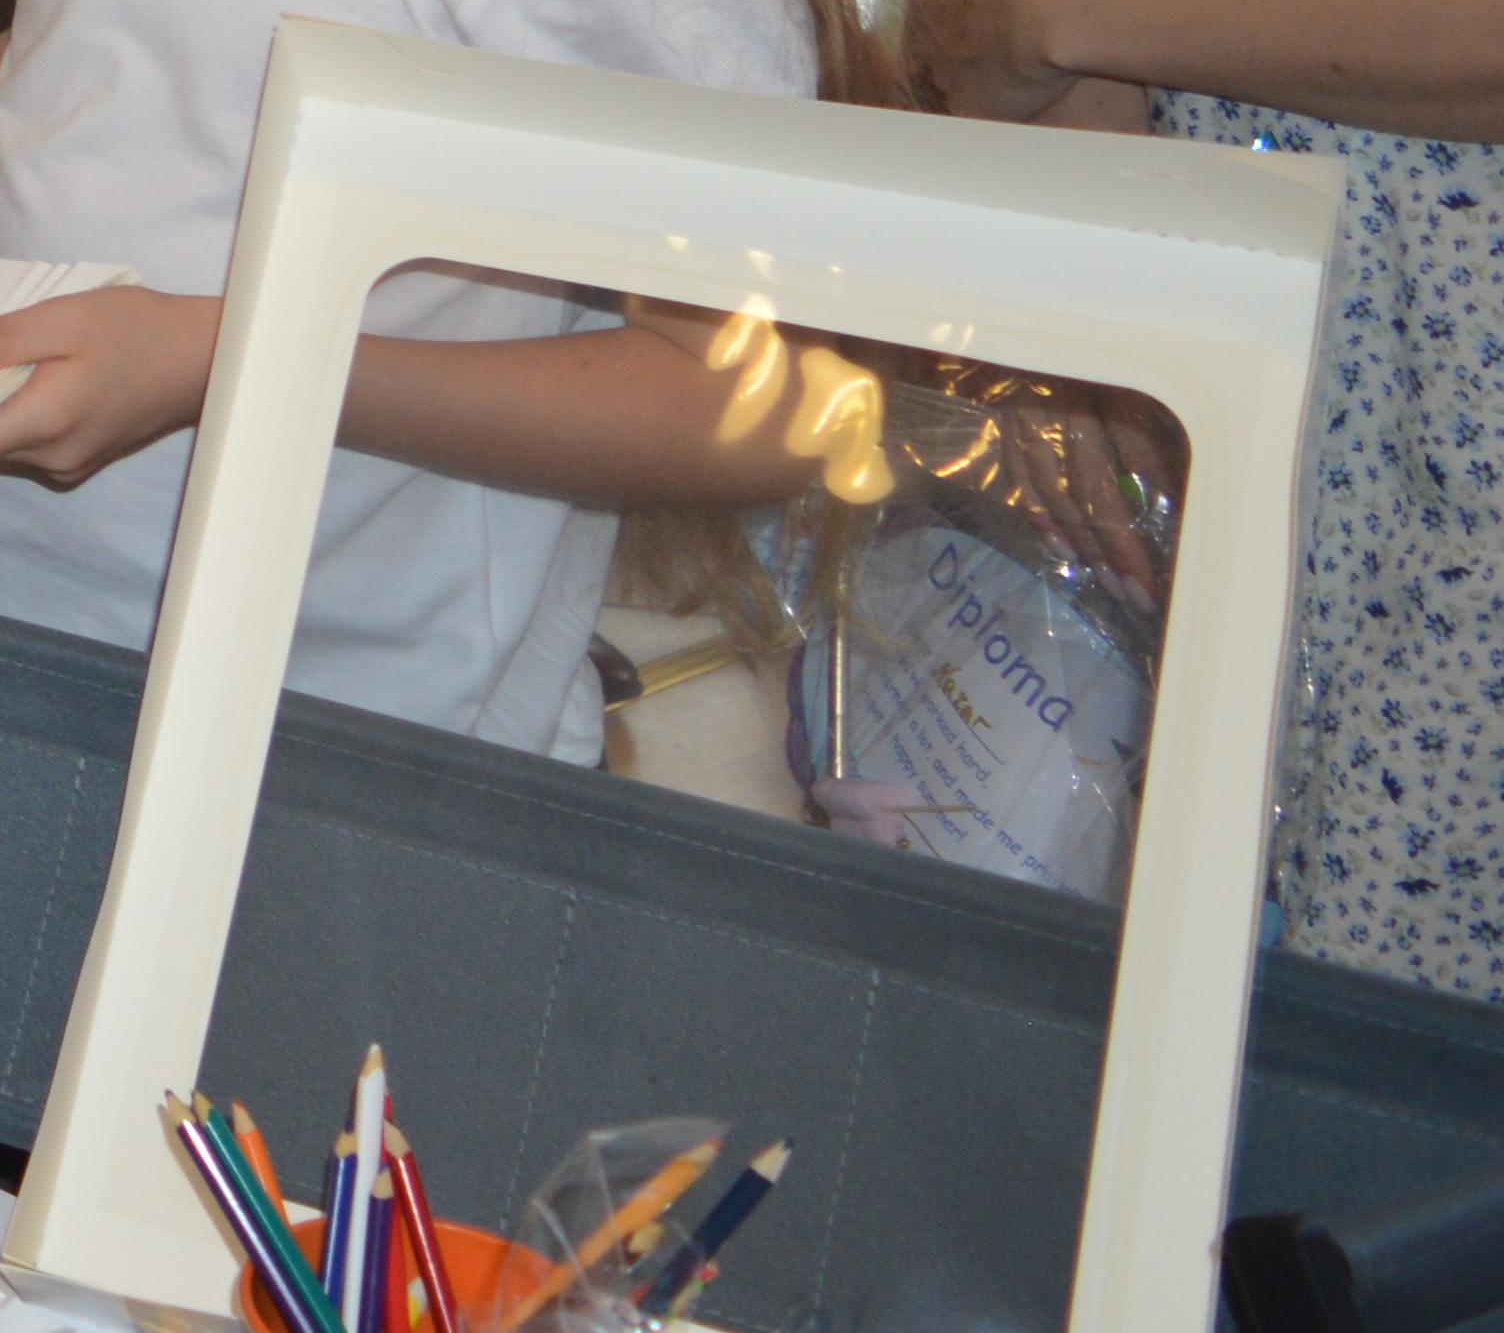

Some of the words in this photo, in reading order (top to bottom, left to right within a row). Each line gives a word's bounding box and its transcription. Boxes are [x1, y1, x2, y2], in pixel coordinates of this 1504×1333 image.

[928, 542, 1075, 732] Diploma
[890, 732, 919, 779] happy
[957, 743, 992, 789] hard,
[932, 758, 955, 788] and
[953, 788, 994, 830] made
[996, 829, 1024, 856] me
